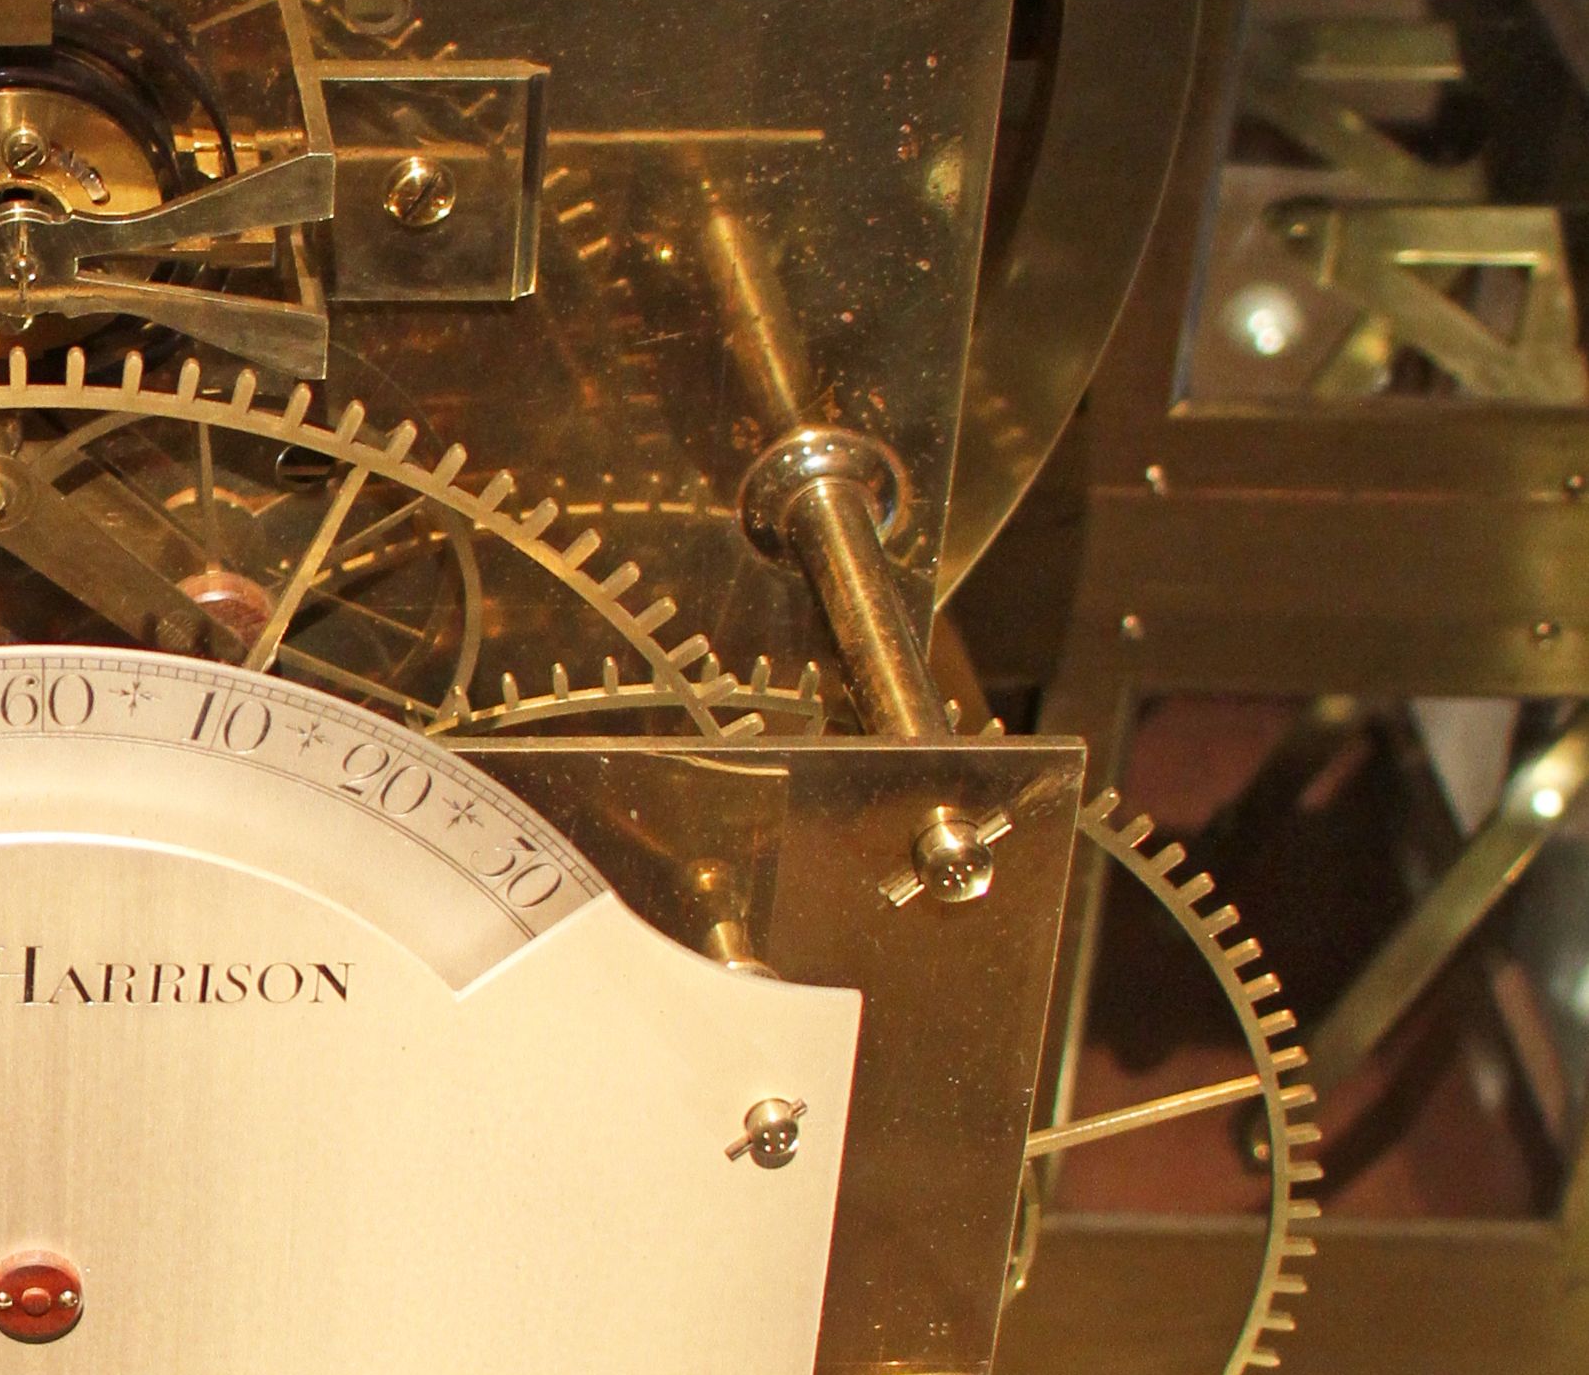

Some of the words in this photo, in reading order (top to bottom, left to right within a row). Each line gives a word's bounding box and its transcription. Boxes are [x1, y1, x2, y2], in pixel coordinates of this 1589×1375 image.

[0, 673, 95, 728] 60
[181, 690, 273, 755] 10
[337, 743, 432, 819] 20
[468, 835, 564, 909] 30
